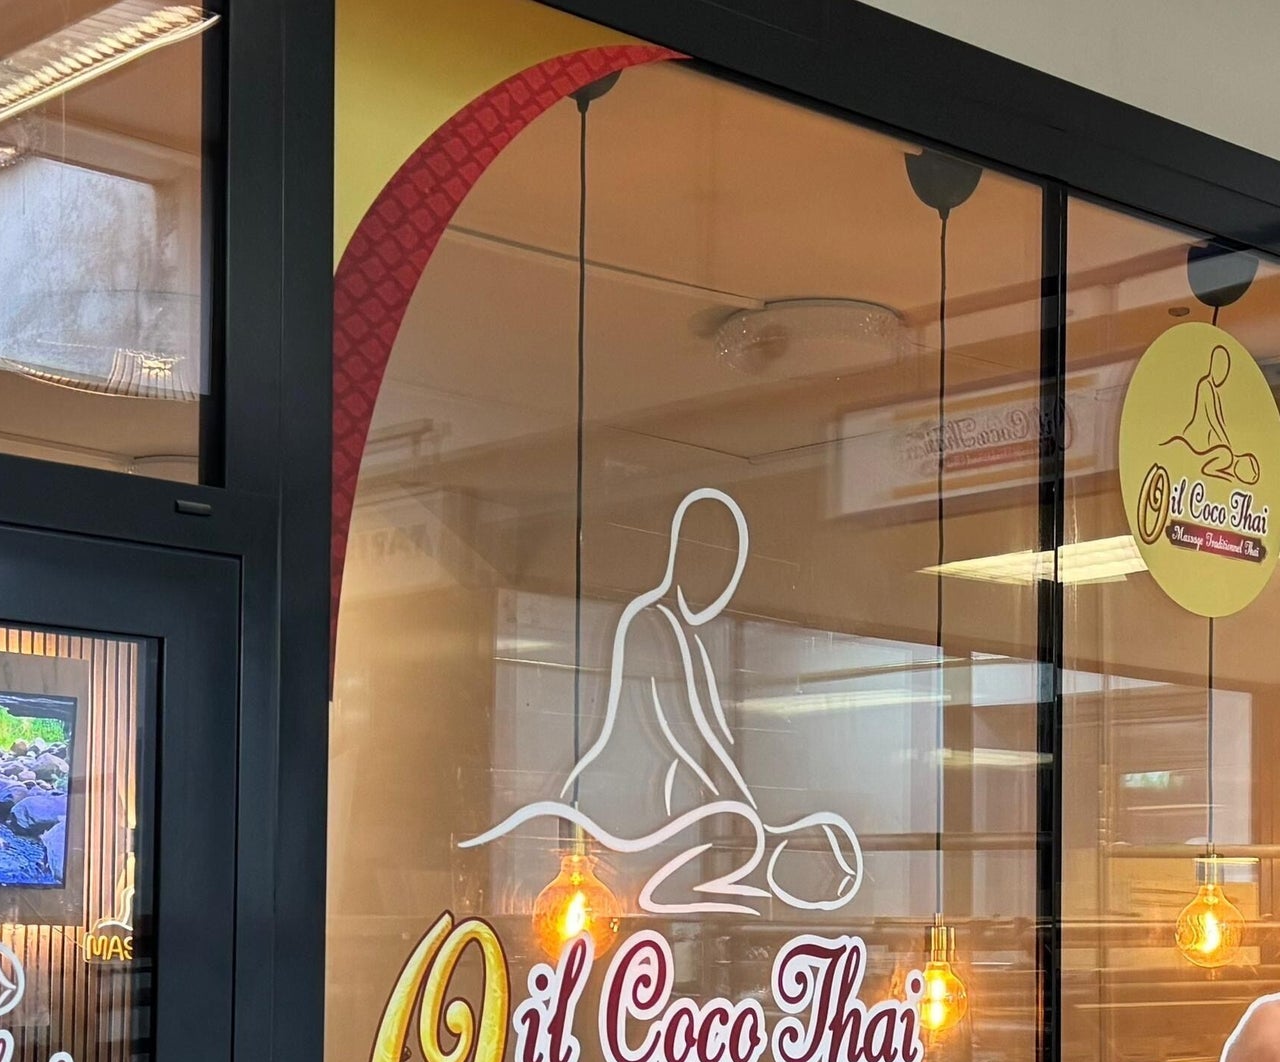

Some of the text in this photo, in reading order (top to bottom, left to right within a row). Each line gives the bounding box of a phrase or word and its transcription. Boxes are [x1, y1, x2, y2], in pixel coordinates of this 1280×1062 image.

[1137, 463, 1268, 545] Oil Coco Thai
[1172, 526, 1204, 551] Massage
[1205, 532, 1243, 554] Traditionnel
